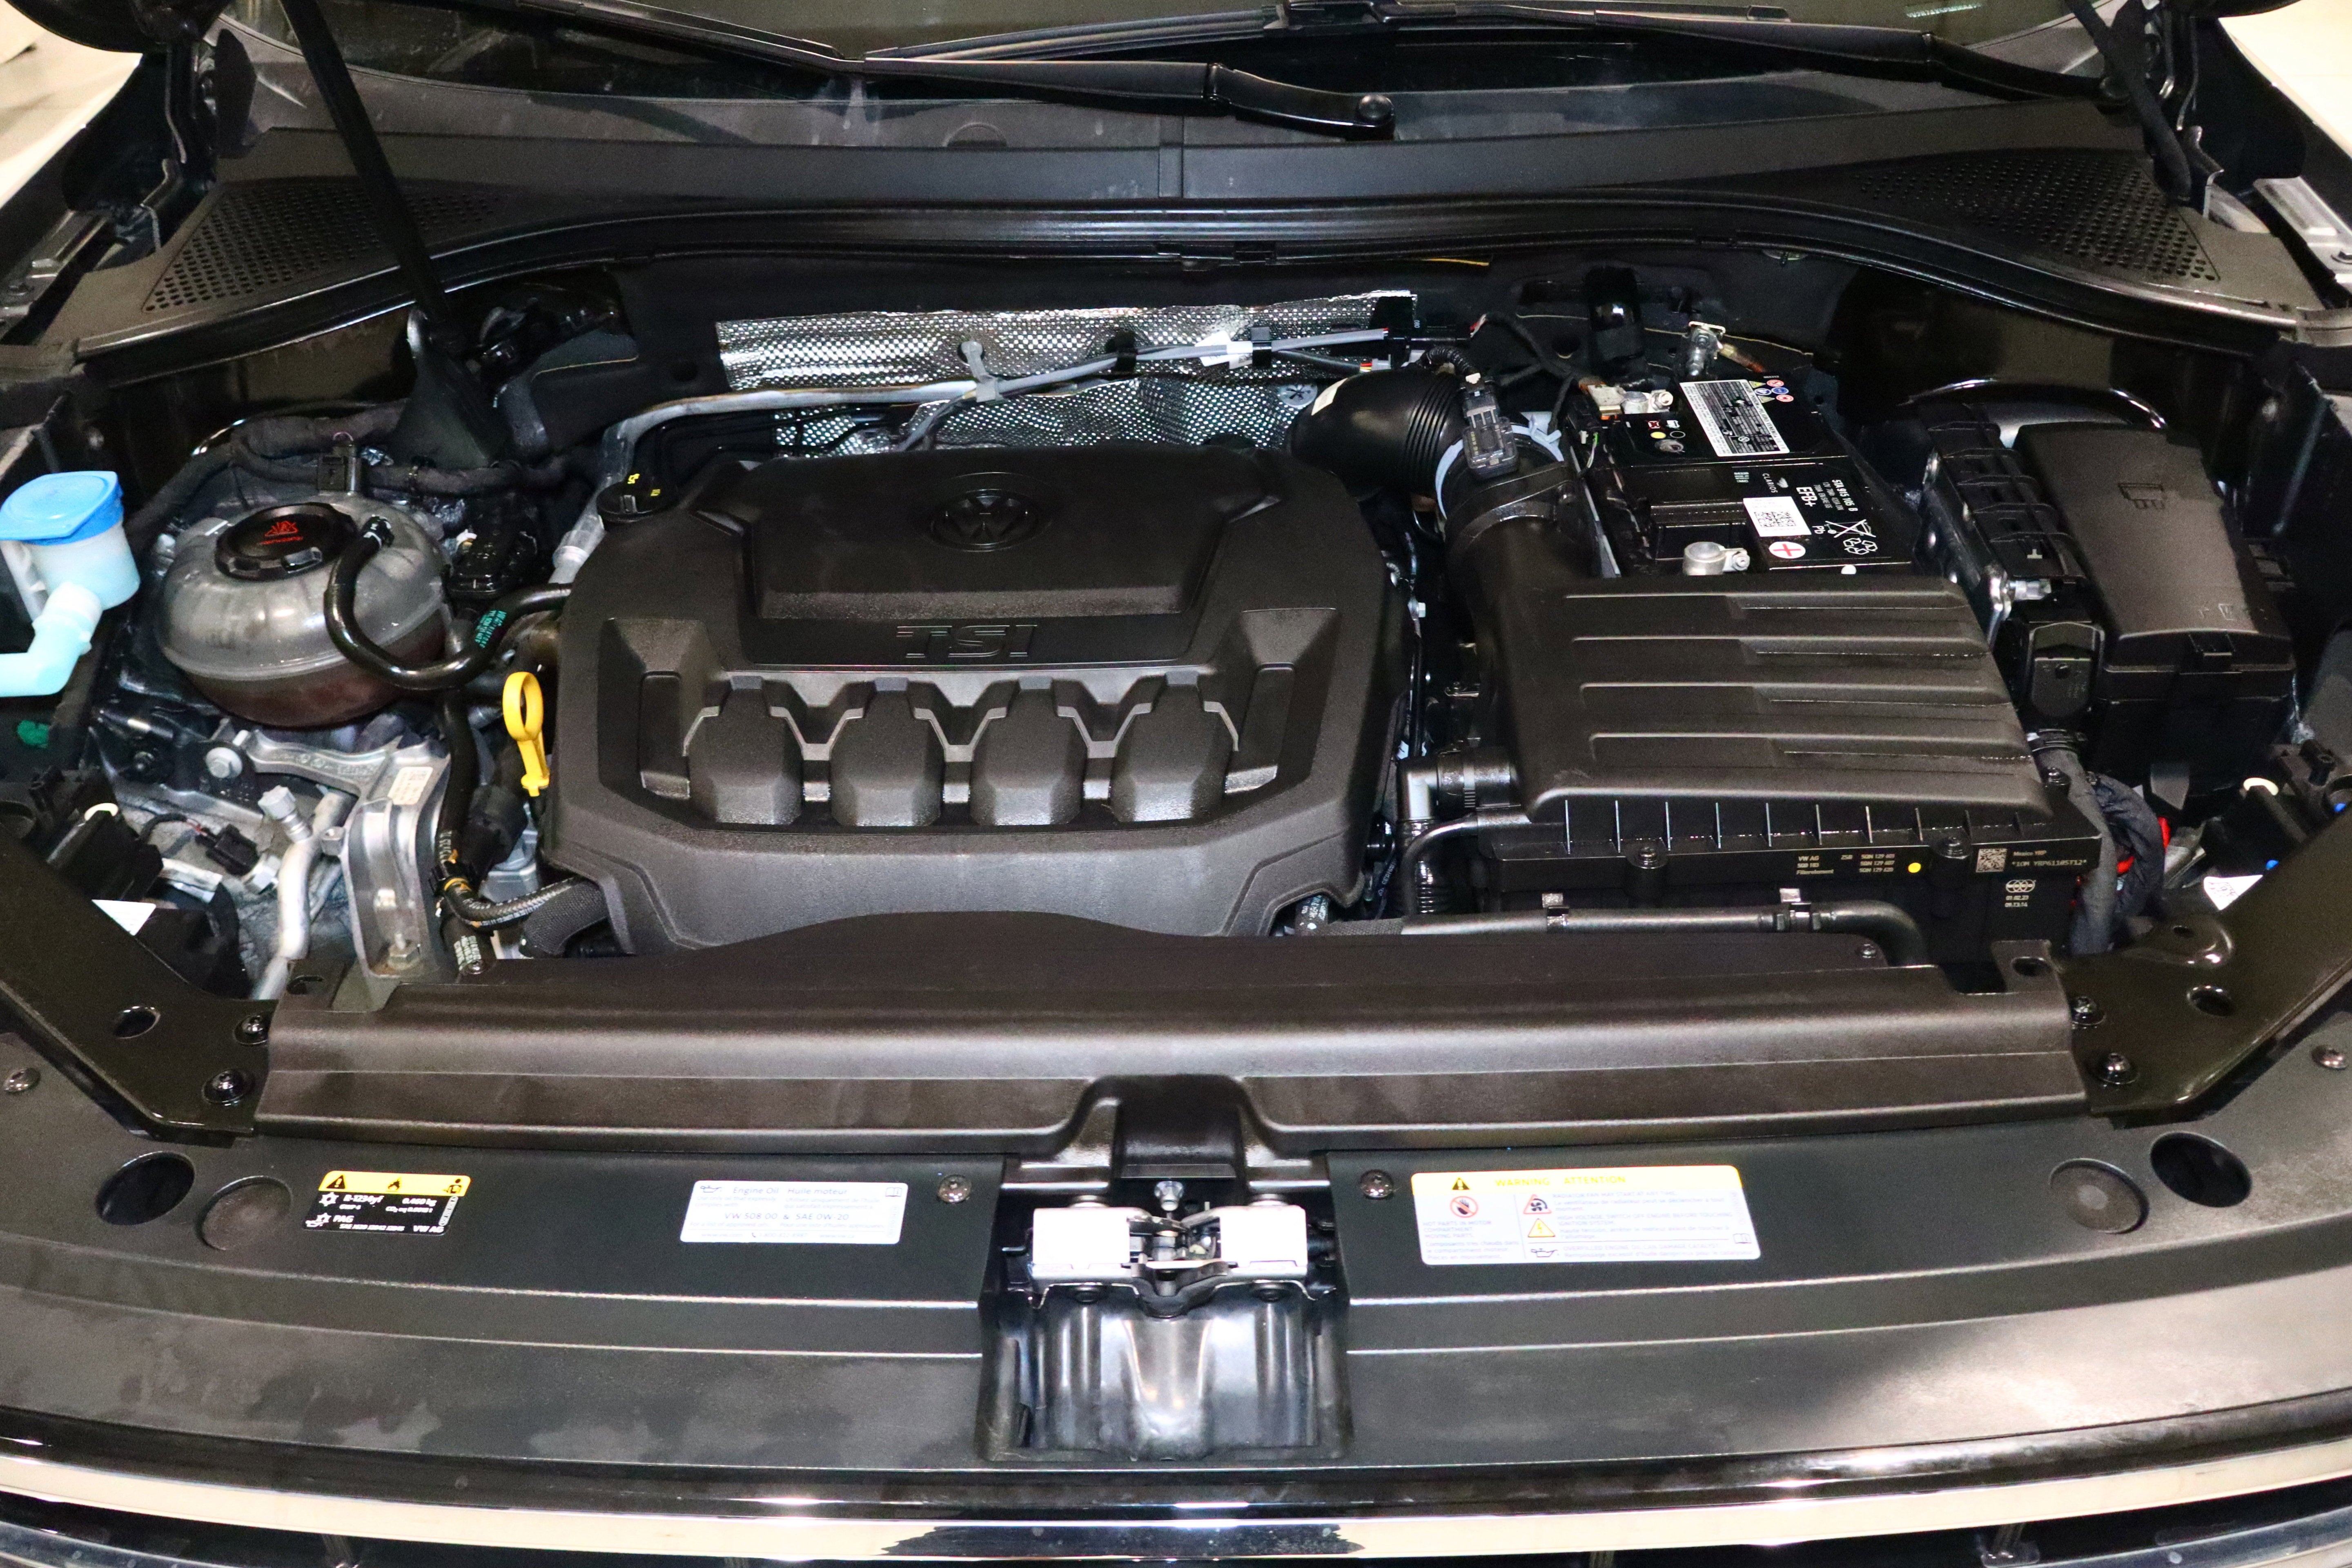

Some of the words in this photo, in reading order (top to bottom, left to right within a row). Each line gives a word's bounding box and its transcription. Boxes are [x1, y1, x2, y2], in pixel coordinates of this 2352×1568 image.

[1762, 473, 1778, 493] CLARIOS
[1832, 479, 1844, 488] 5TA
[1796, 487, 1817, 507] EFB+
[1837, 488, 1850, 497] 915
[1842, 497, 1855, 506] 105
[1812, 525, 1826, 534] Pb
[896, 624, 1038, 658] TSI
[1494, 1178, 1550, 1186] WARNING
[1563, 1176, 1626, 1185] ATTENTION
[733, 1187, 764, 1196] Engine
[343, 1194, 384, 1205] R-1234yf
[333, 1215, 354, 1223] PAG
